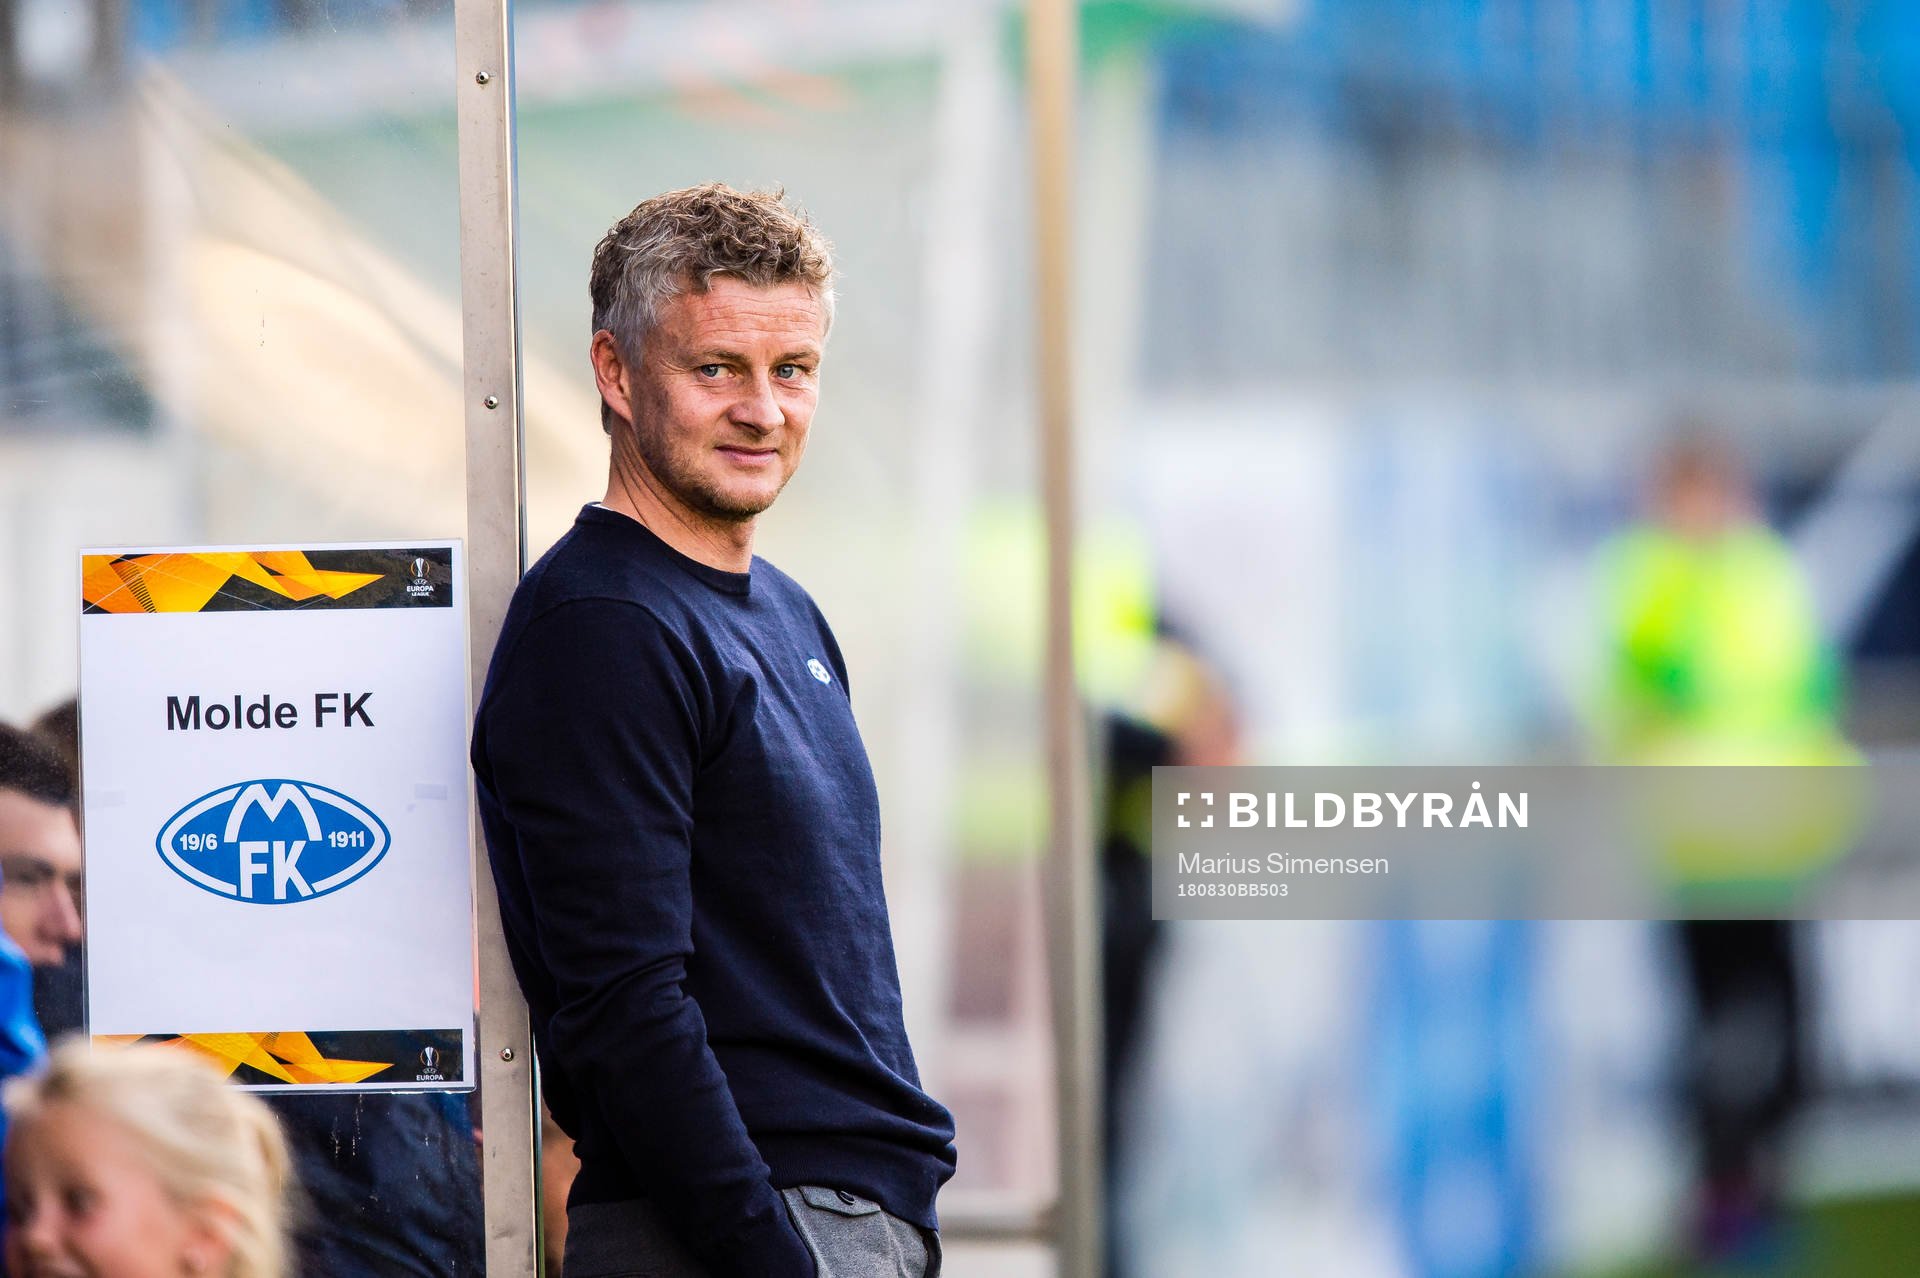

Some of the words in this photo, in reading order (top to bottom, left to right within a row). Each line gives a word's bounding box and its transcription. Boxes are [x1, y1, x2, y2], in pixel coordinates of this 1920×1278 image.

[167, 695, 298, 730] Molde
[315, 692, 375, 728] FK
[180, 833, 218, 852] 19/6
[328, 831, 365, 848] 1911
[239, 840, 313, 900] FK
